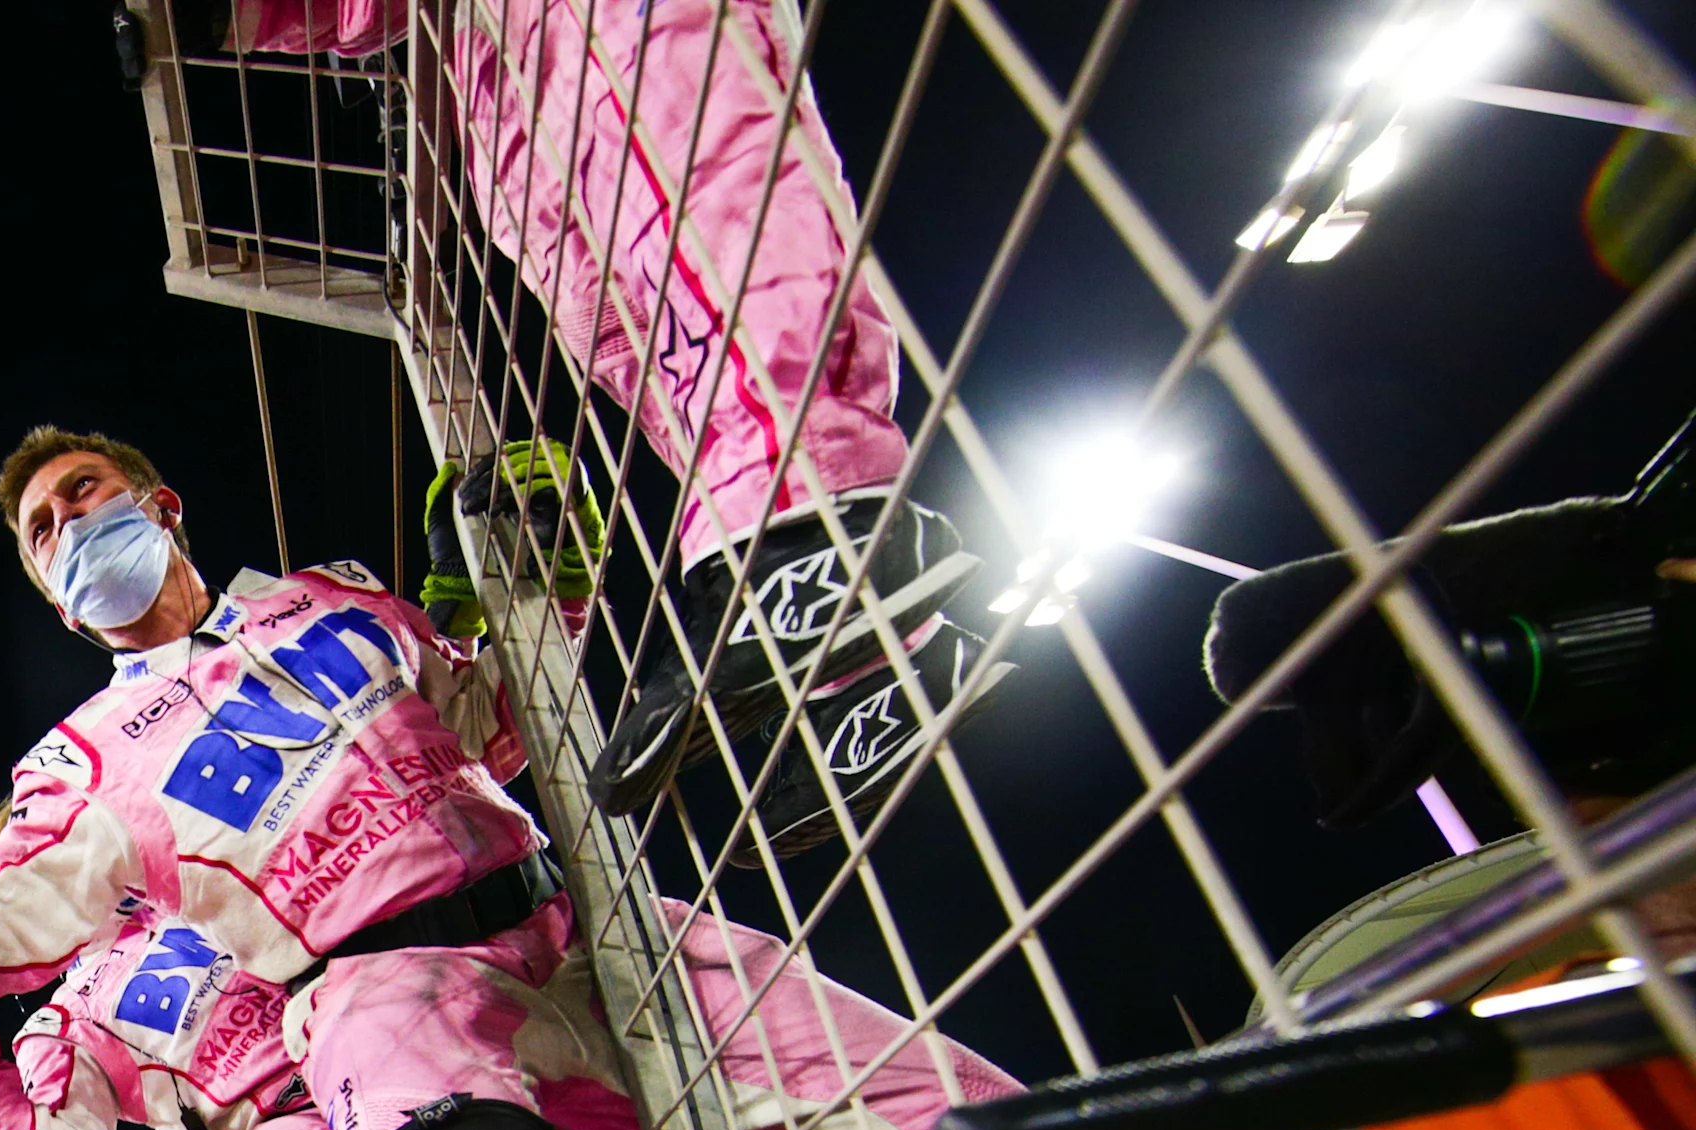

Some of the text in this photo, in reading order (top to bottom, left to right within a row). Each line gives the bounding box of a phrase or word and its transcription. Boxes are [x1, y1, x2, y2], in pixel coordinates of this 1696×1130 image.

[120, 677, 194, 740] JCB
[162, 606, 401, 832] BWT
[264, 786, 297, 832] BEST
[292, 741, 336, 793] WATER
[116, 927, 219, 1035] BW
[181, 998, 201, 1031] BEST
